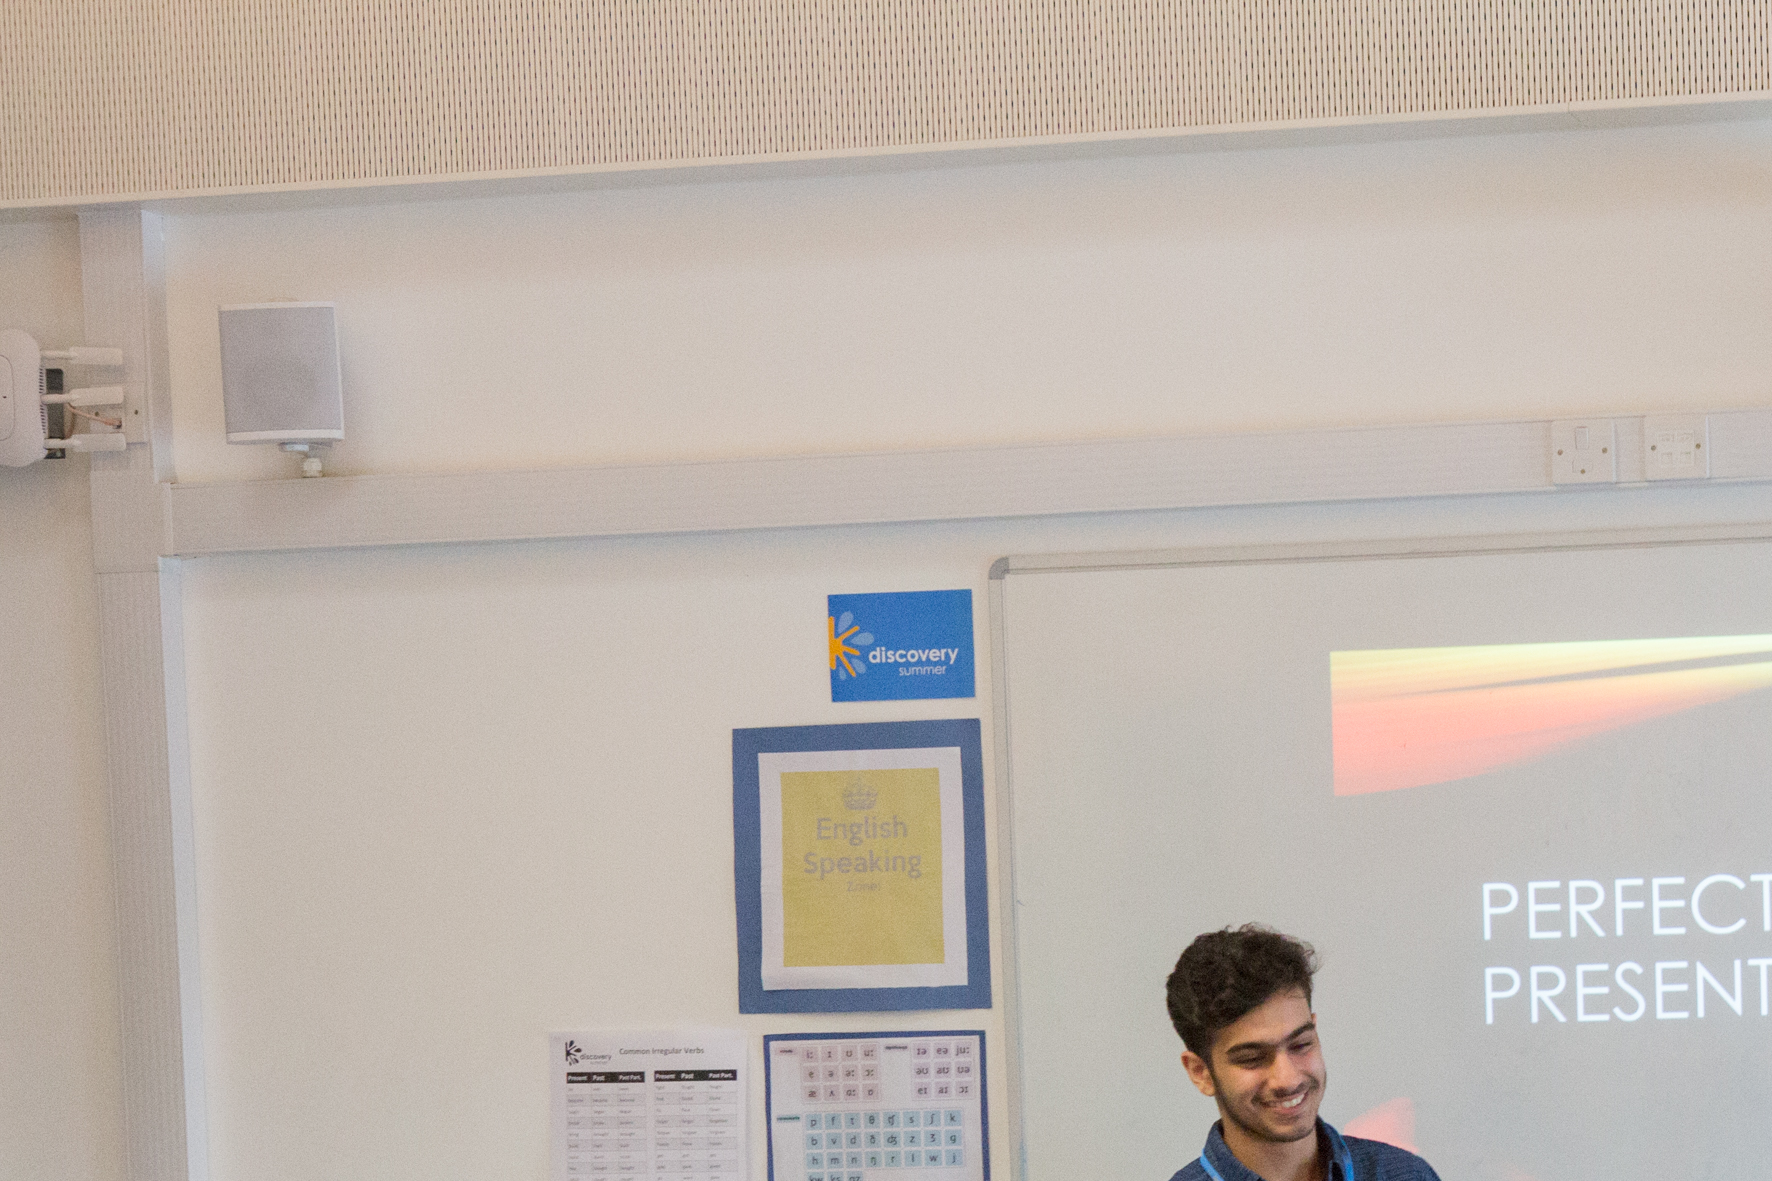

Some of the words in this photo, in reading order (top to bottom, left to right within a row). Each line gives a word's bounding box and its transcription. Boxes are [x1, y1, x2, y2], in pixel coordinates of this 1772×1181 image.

[868, 646, 958, 664] discovery
[898, 664, 947, 676] summer
[815, 814, 909, 847] English
[803, 850, 922, 880] Speaking
[580, 1053, 612, 1062] discovery
